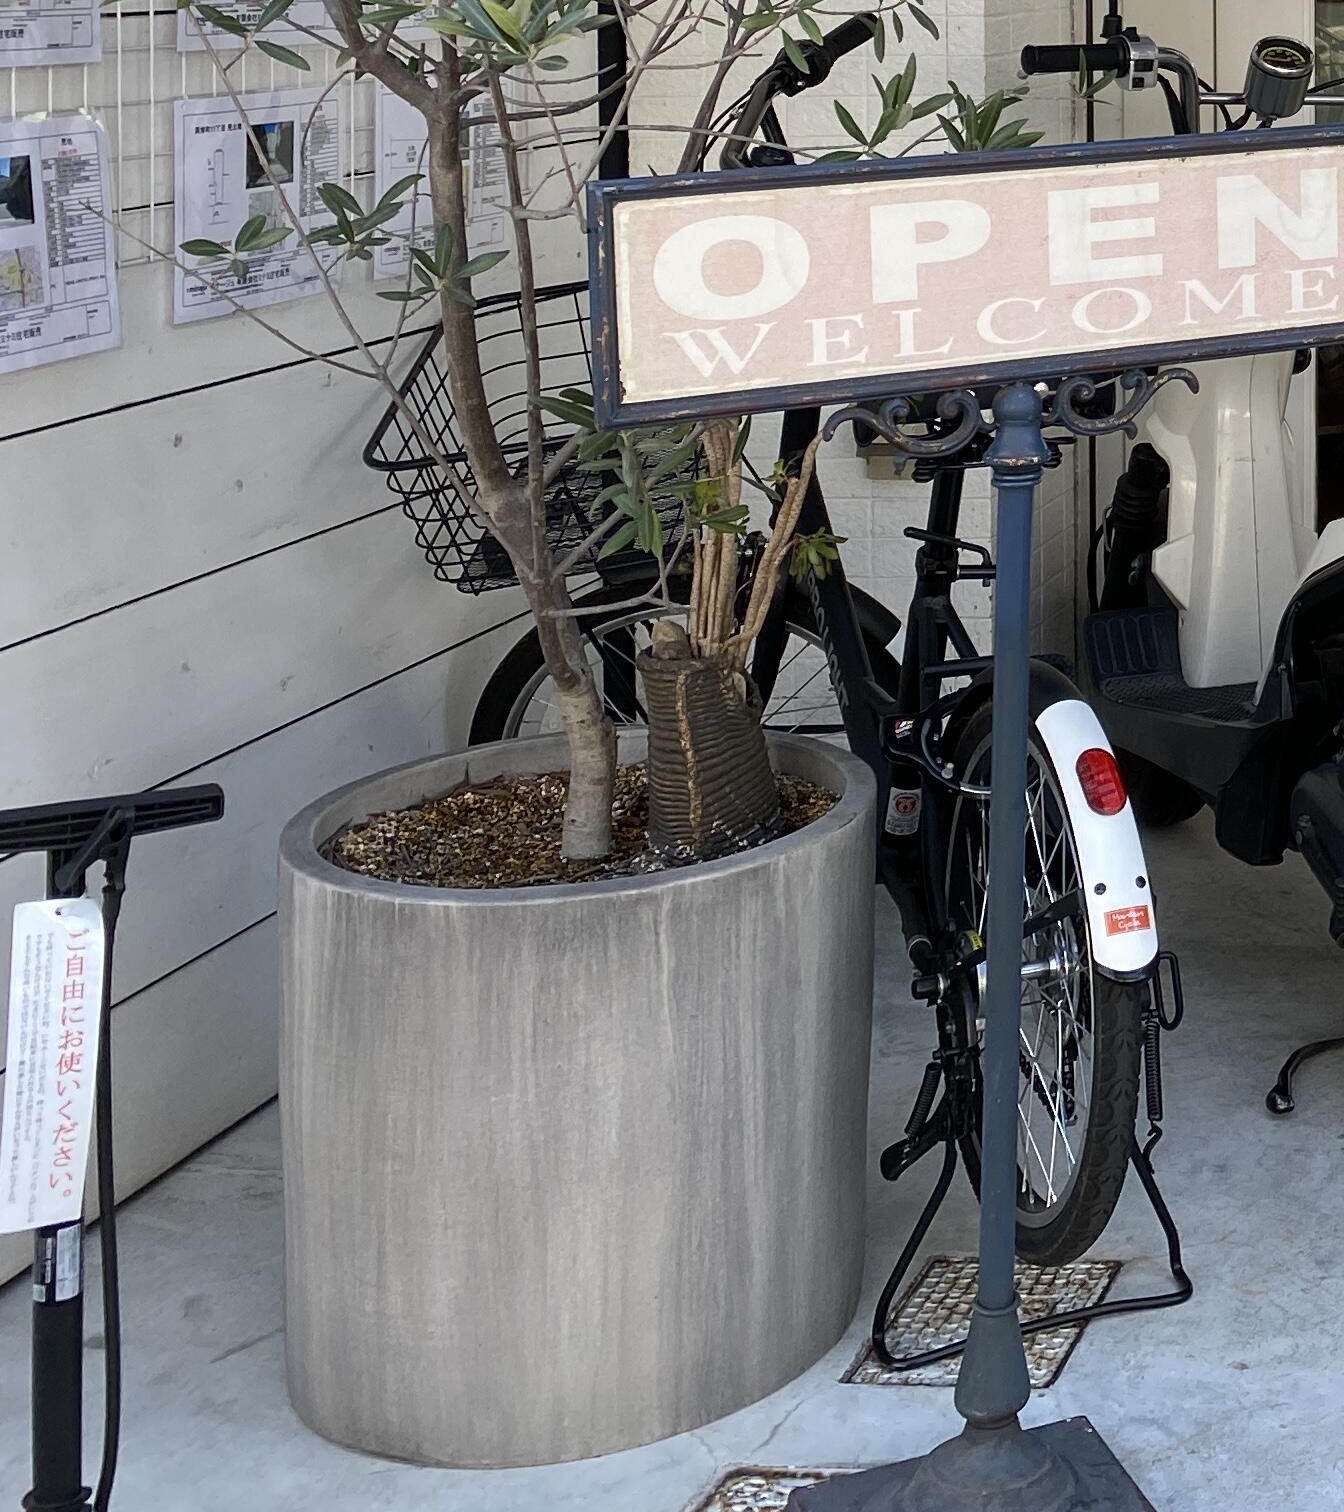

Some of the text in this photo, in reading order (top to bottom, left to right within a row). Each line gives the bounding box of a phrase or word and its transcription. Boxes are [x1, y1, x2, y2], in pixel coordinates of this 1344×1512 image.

[653, 167, 1339, 321] OPEN
[665, 265, 1340, 378] WELCOME
[49, 929, 89, 1199] ご自由にお使いください。
